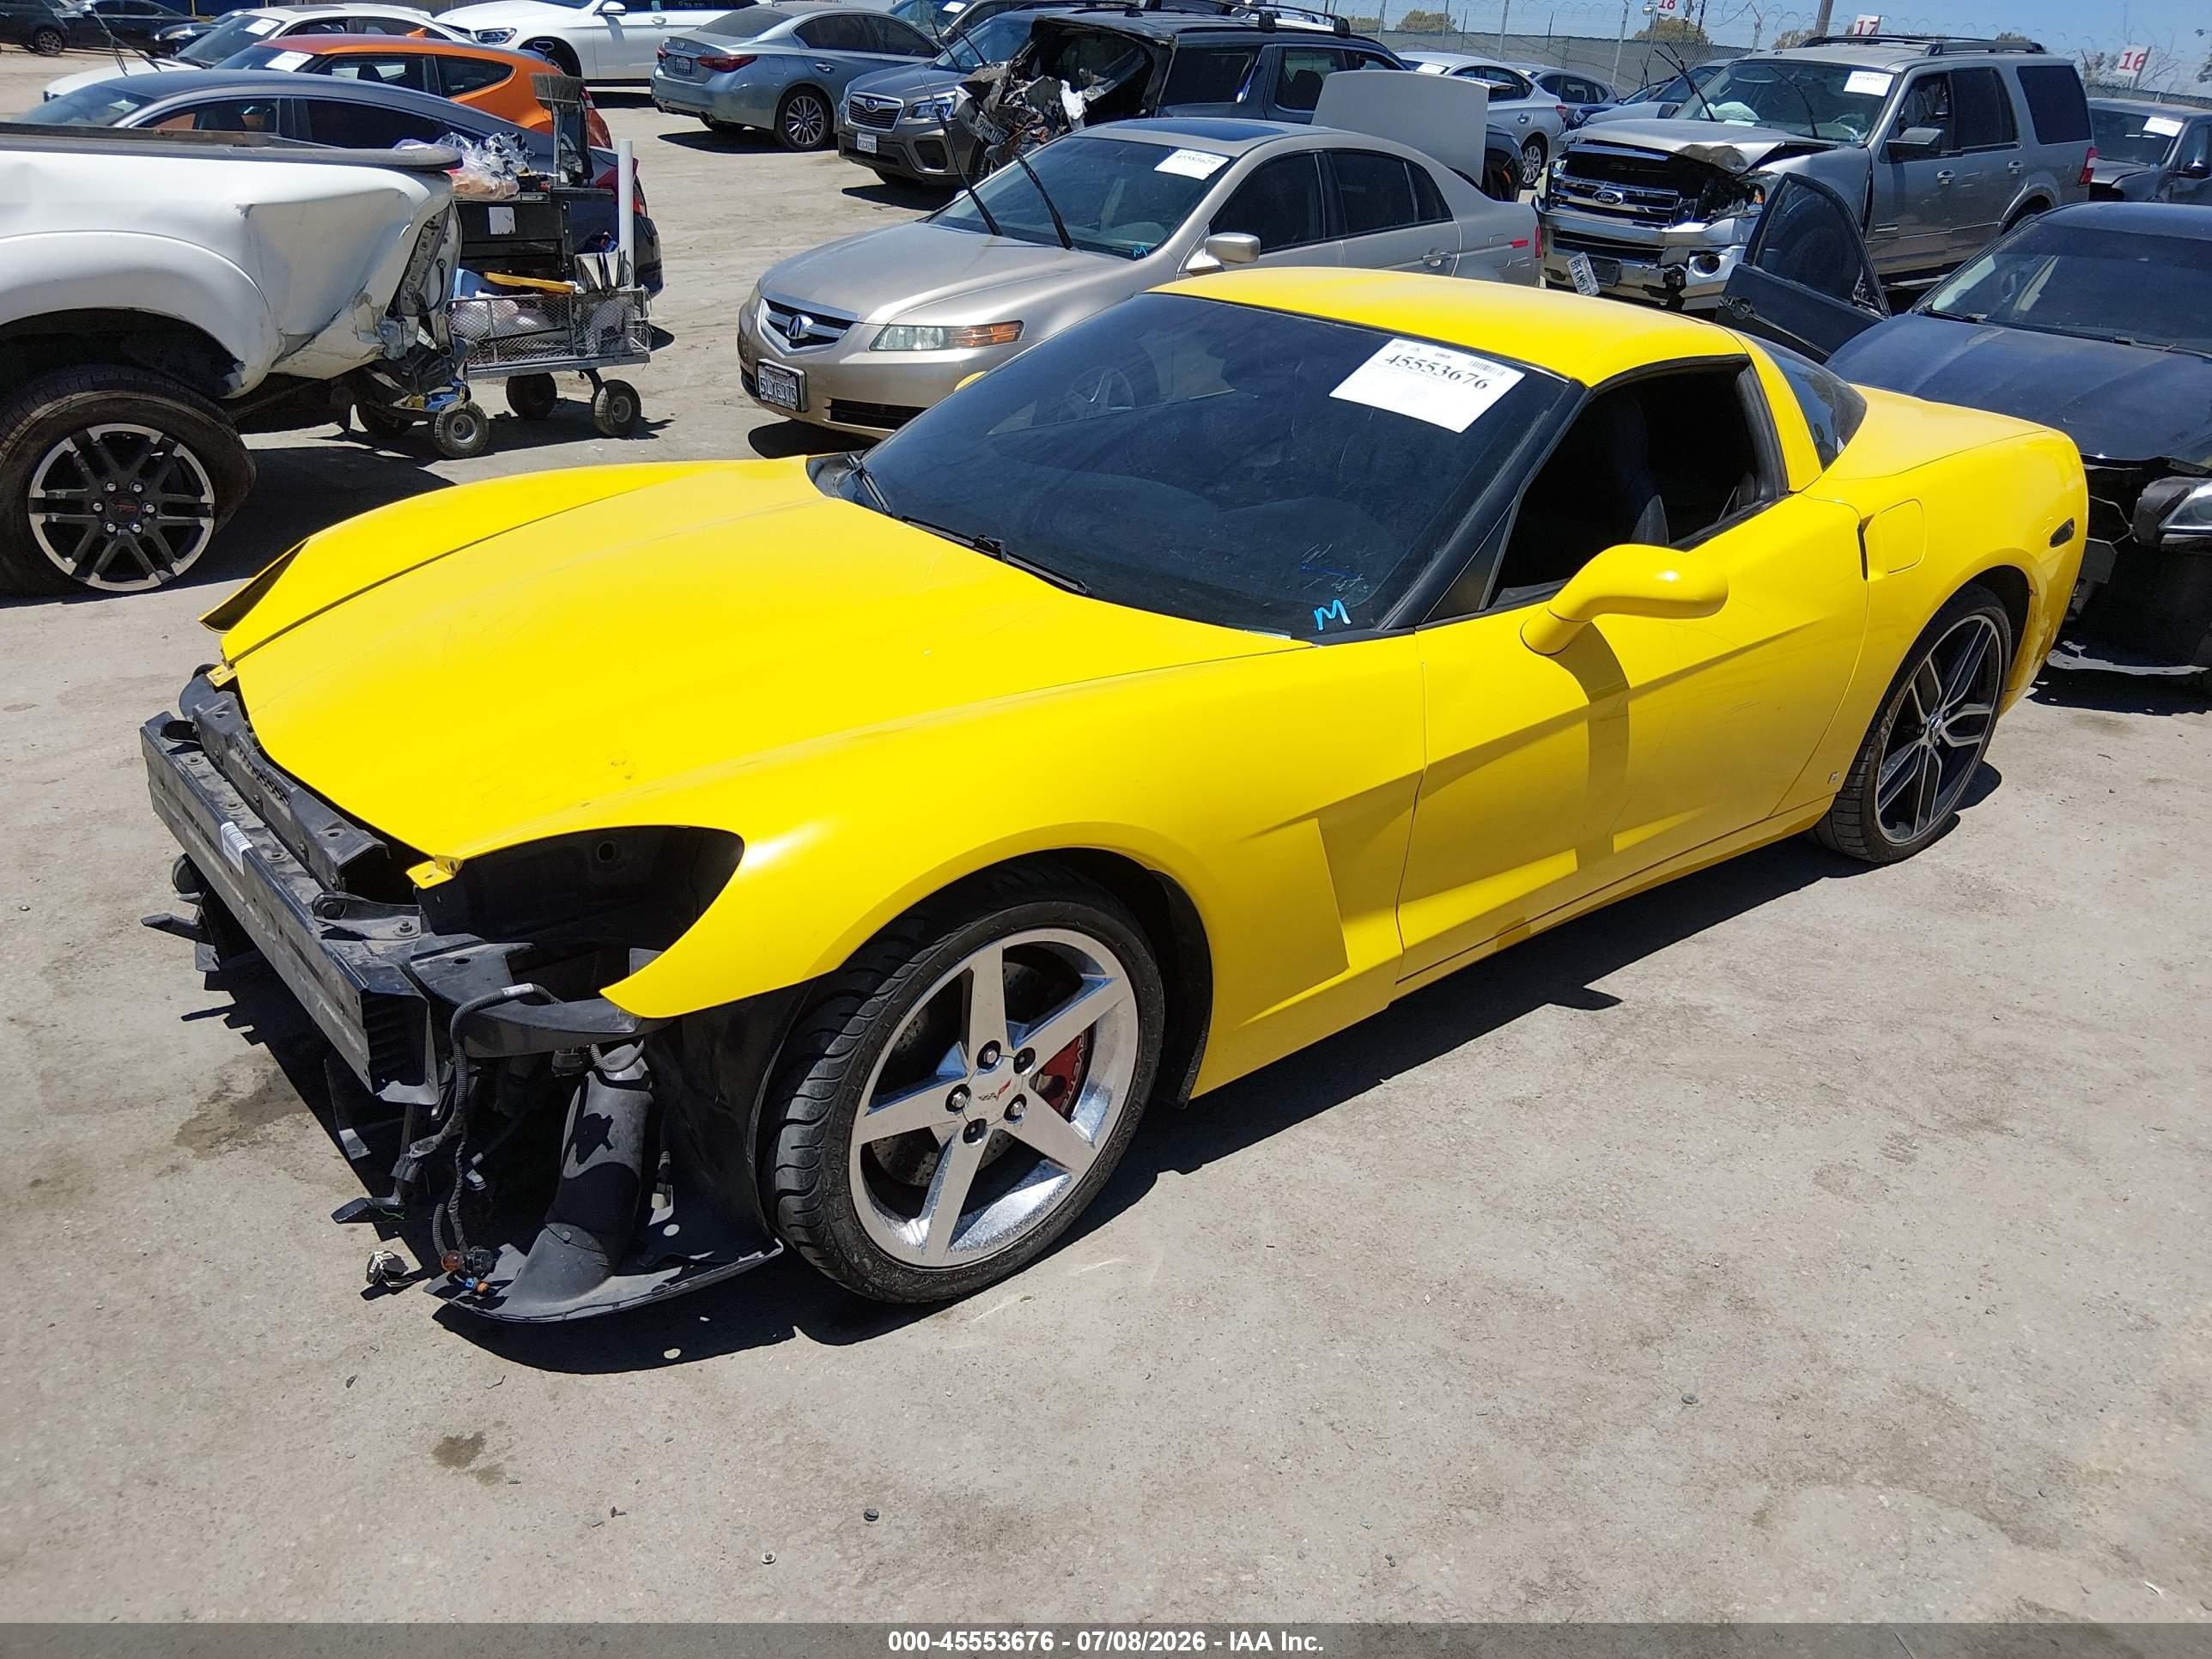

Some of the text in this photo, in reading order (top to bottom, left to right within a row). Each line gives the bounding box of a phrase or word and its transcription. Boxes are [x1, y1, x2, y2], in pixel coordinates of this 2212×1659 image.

[1658, 0, 1676, 10] 18
[1857, 20, 1878, 36] 17
[2119, 52, 2148, 72] 16
[1385, 353, 1489, 391] 45553676
[1313, 599, 1352, 630] M
